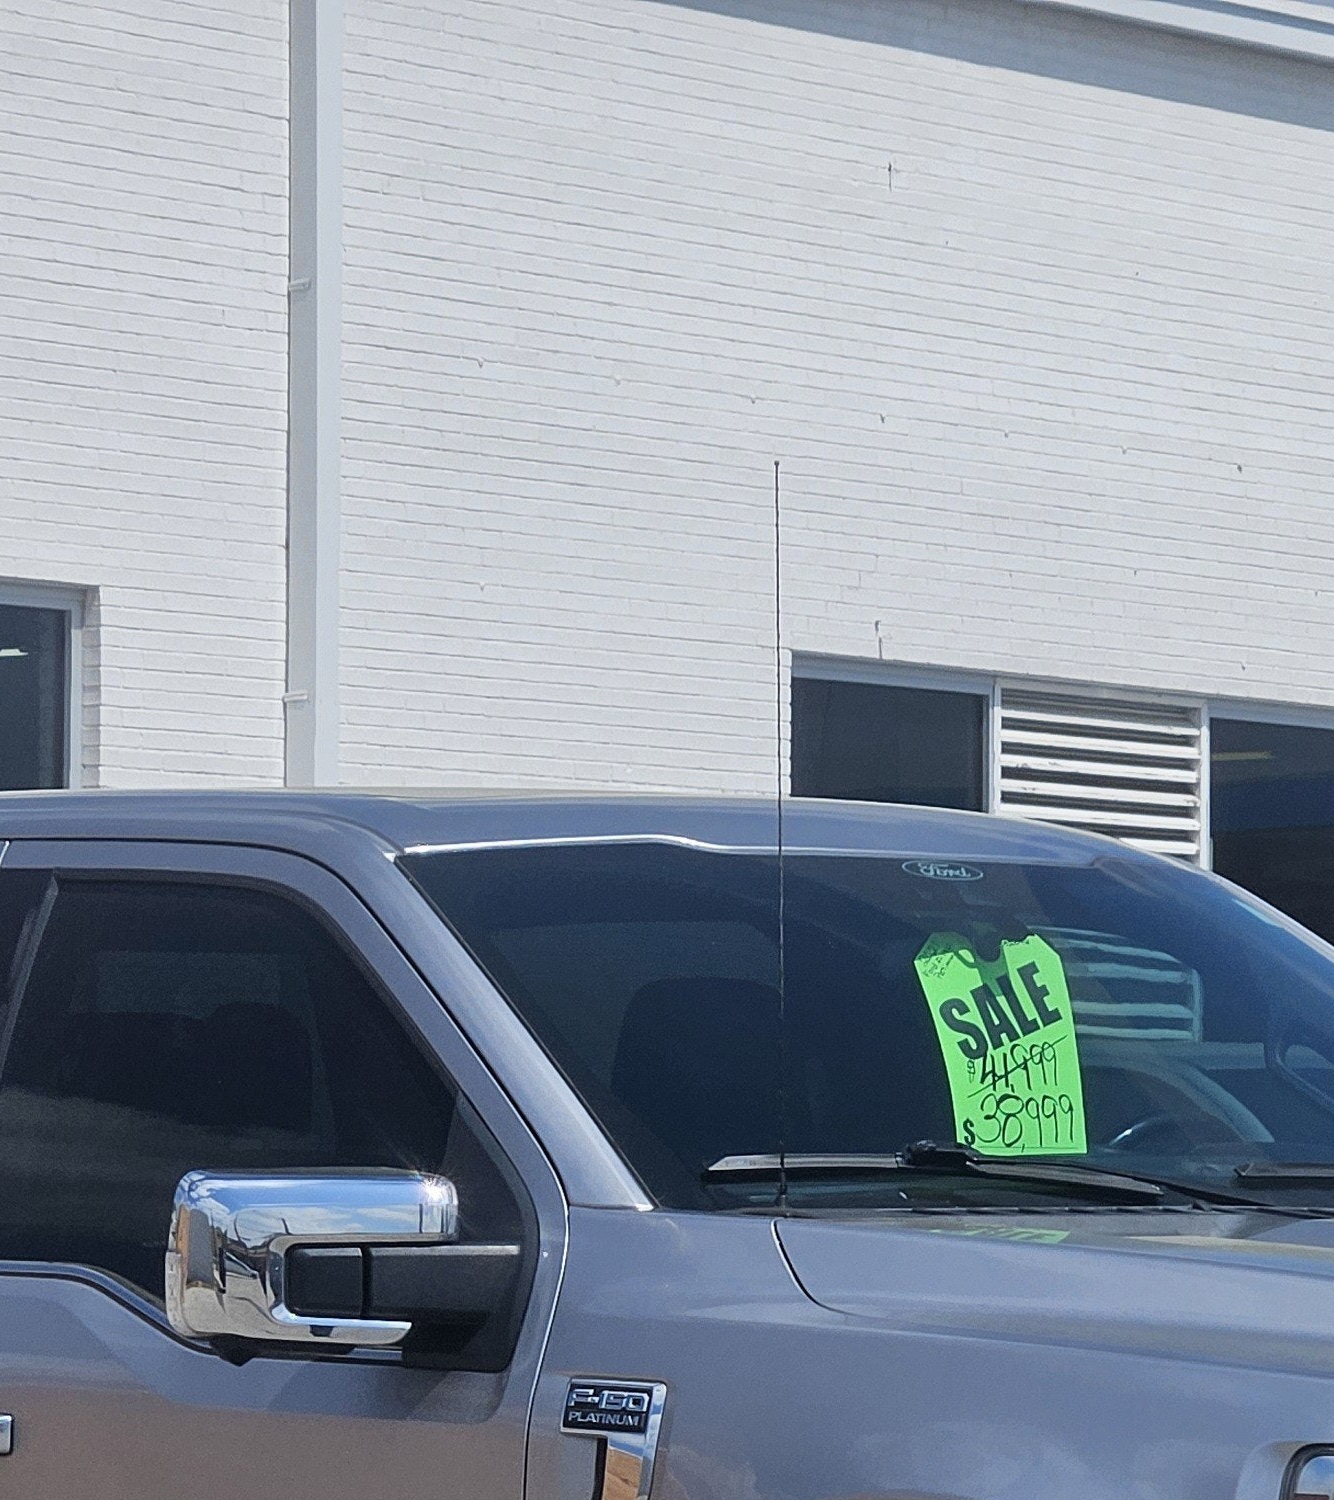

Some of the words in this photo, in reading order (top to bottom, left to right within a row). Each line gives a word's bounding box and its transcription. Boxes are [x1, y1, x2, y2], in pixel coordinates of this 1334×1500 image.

[939, 961, 1063, 1060] SALE
[567, 1387, 650, 1413] F-150
[567, 1411, 641, 1427] PLATINUM
